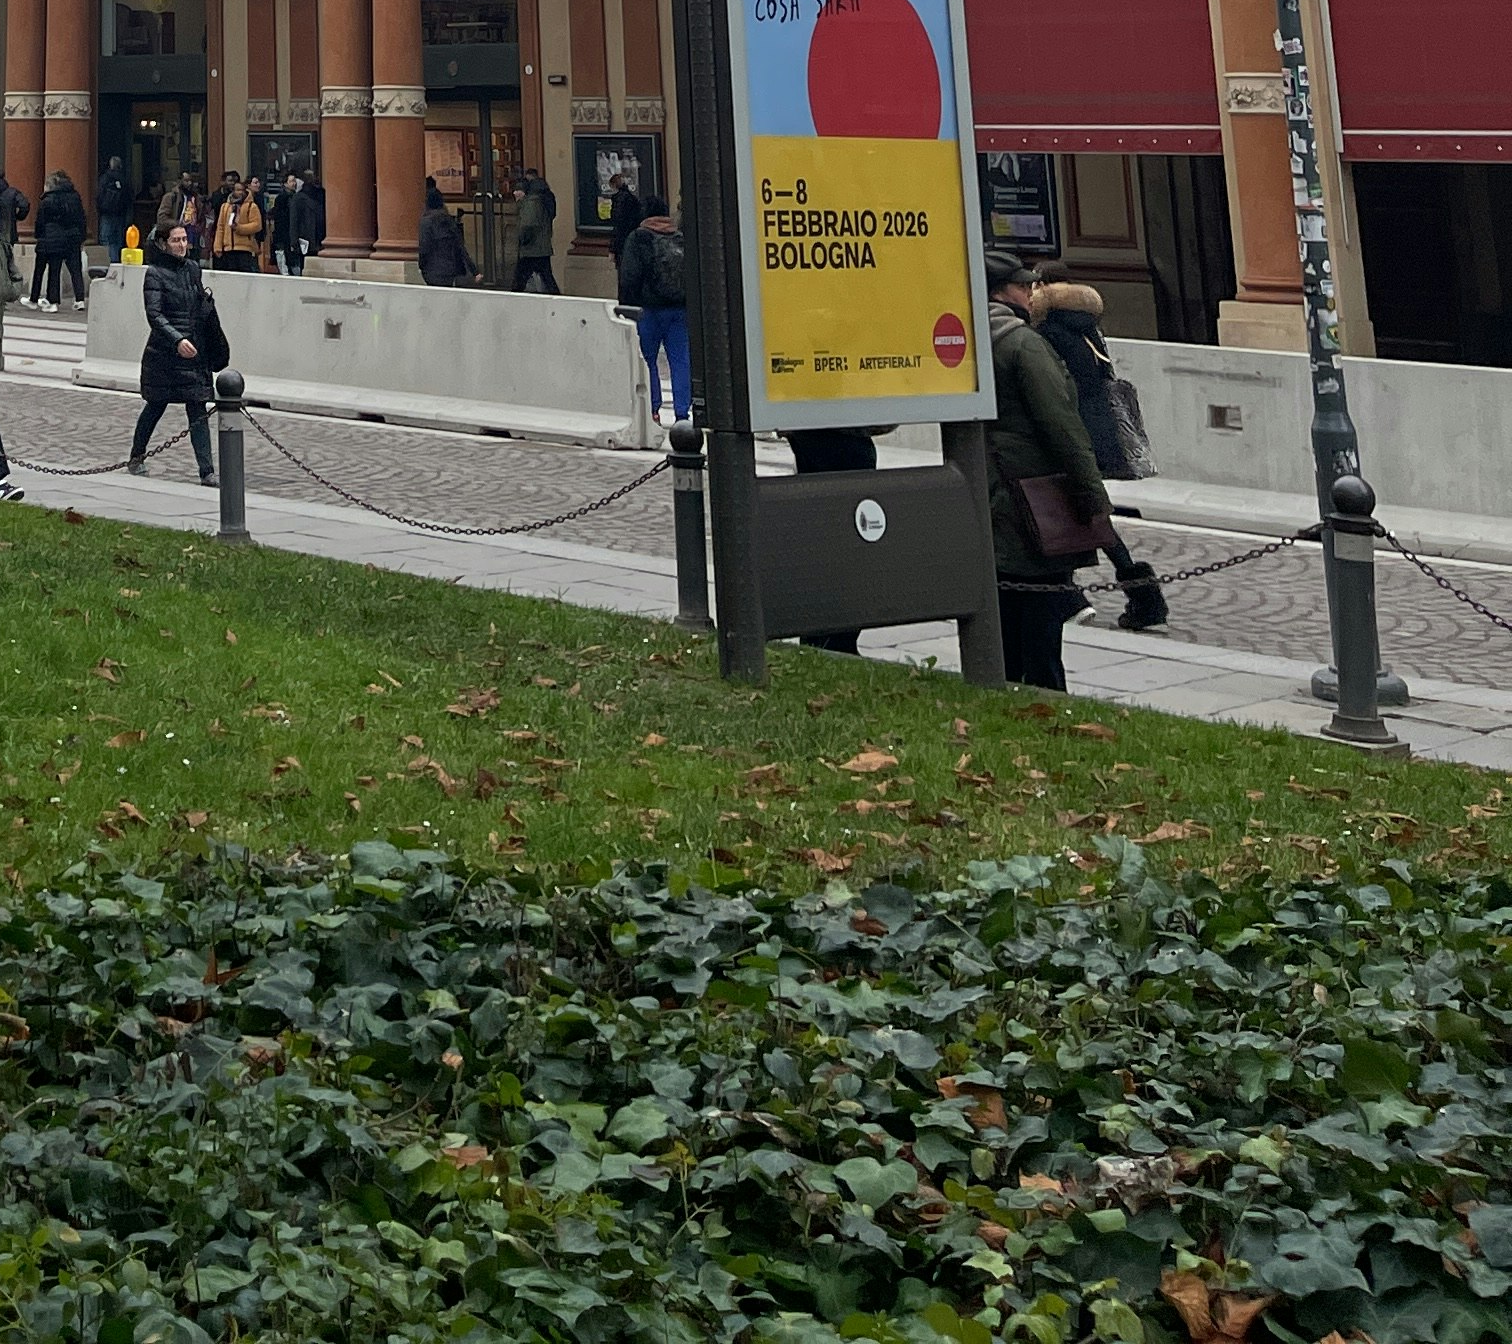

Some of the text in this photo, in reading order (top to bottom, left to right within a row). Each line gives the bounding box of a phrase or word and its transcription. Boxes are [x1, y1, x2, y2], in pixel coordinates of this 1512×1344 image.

[763, 210, 929, 237] FEBBRAIO 2026
[765, 241, 876, 269] BOLOGNA
[859, 355, 922, 371] ARTEFIERA.IT
